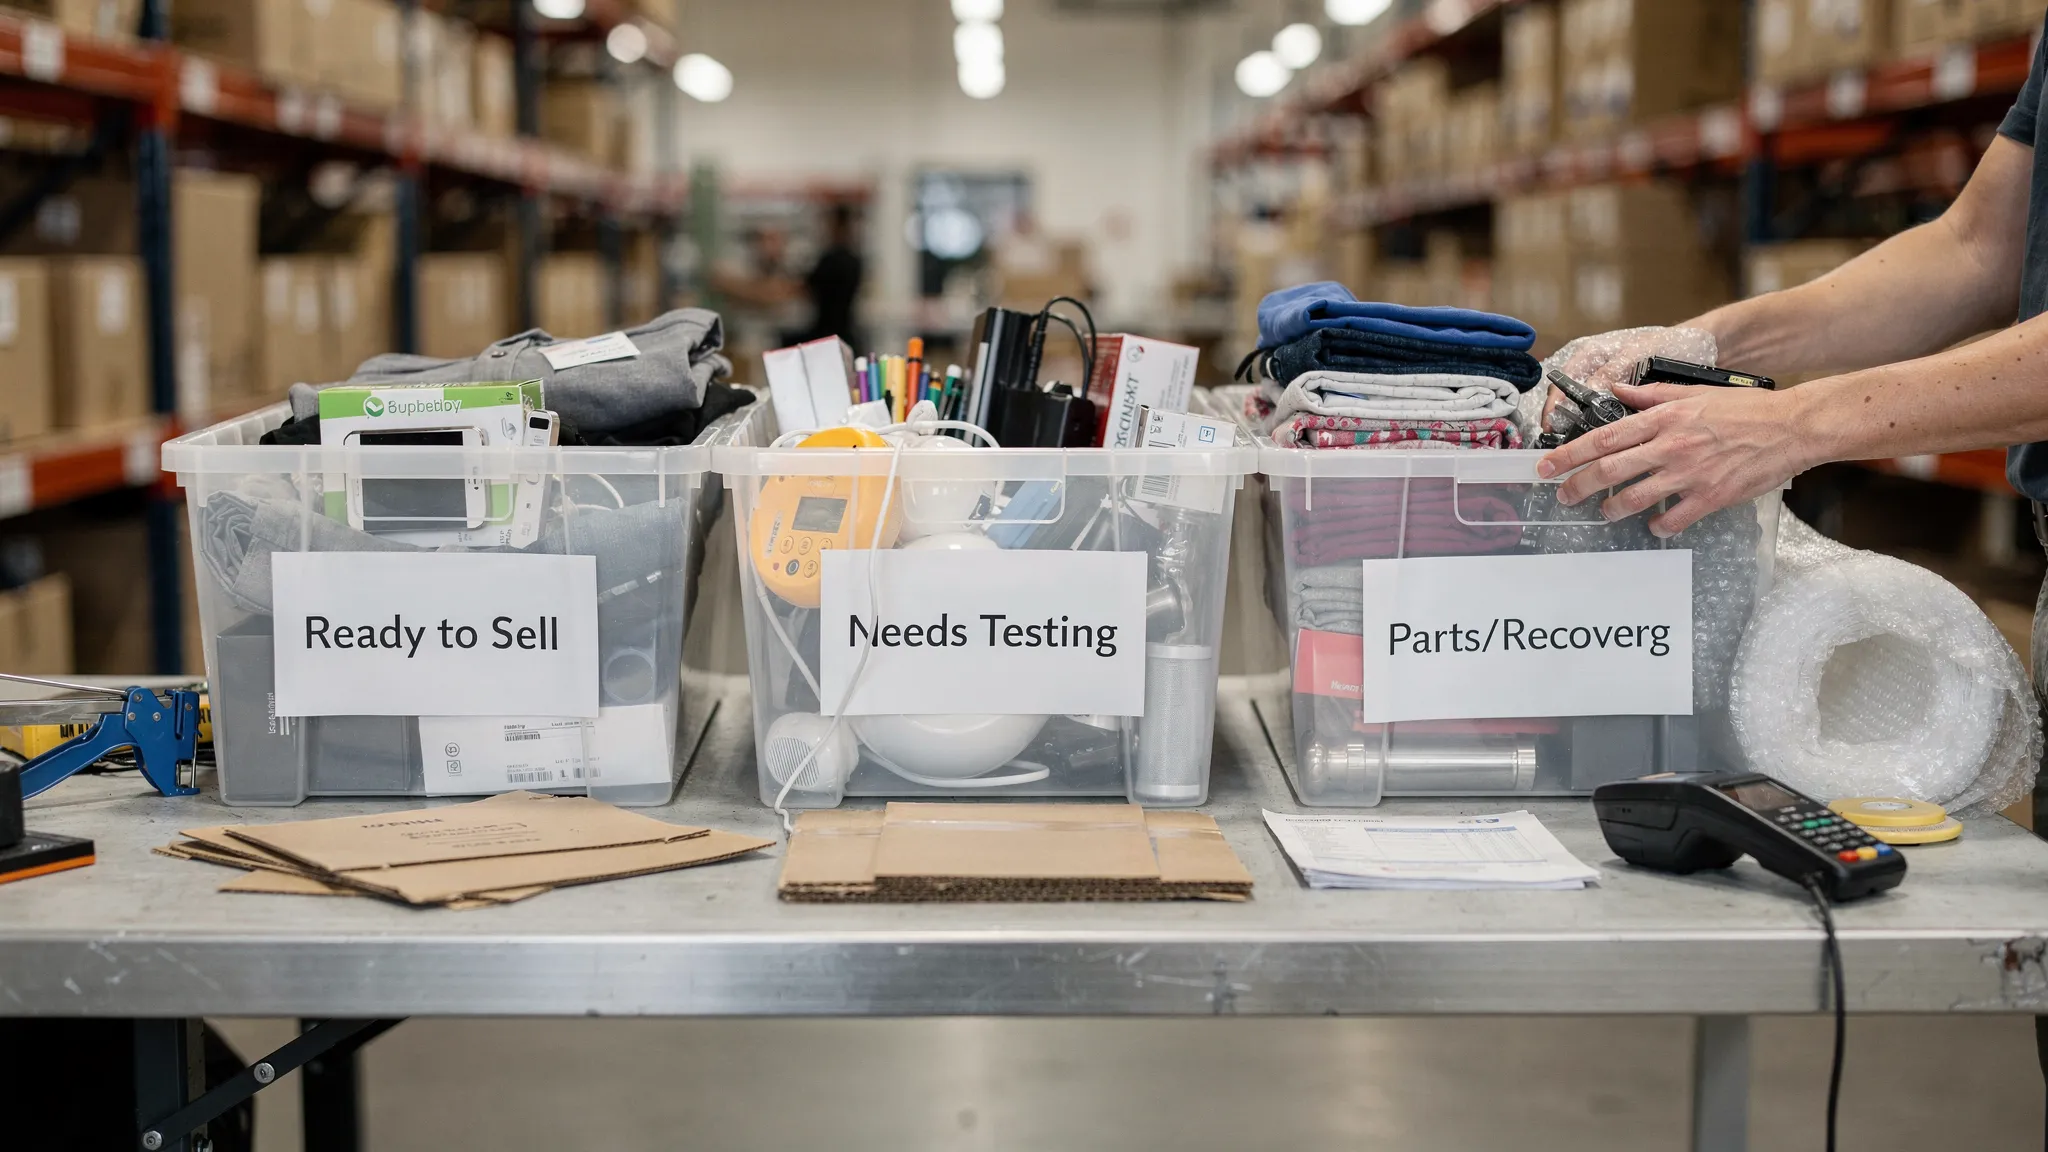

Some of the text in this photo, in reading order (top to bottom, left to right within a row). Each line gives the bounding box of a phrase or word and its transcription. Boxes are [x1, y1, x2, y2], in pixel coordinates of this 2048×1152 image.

[305, 614, 559, 659] Ready to Sell
[849, 613, 1118, 658] Needs Testing
[1389, 618, 1671, 657] Parts/Recoverg
